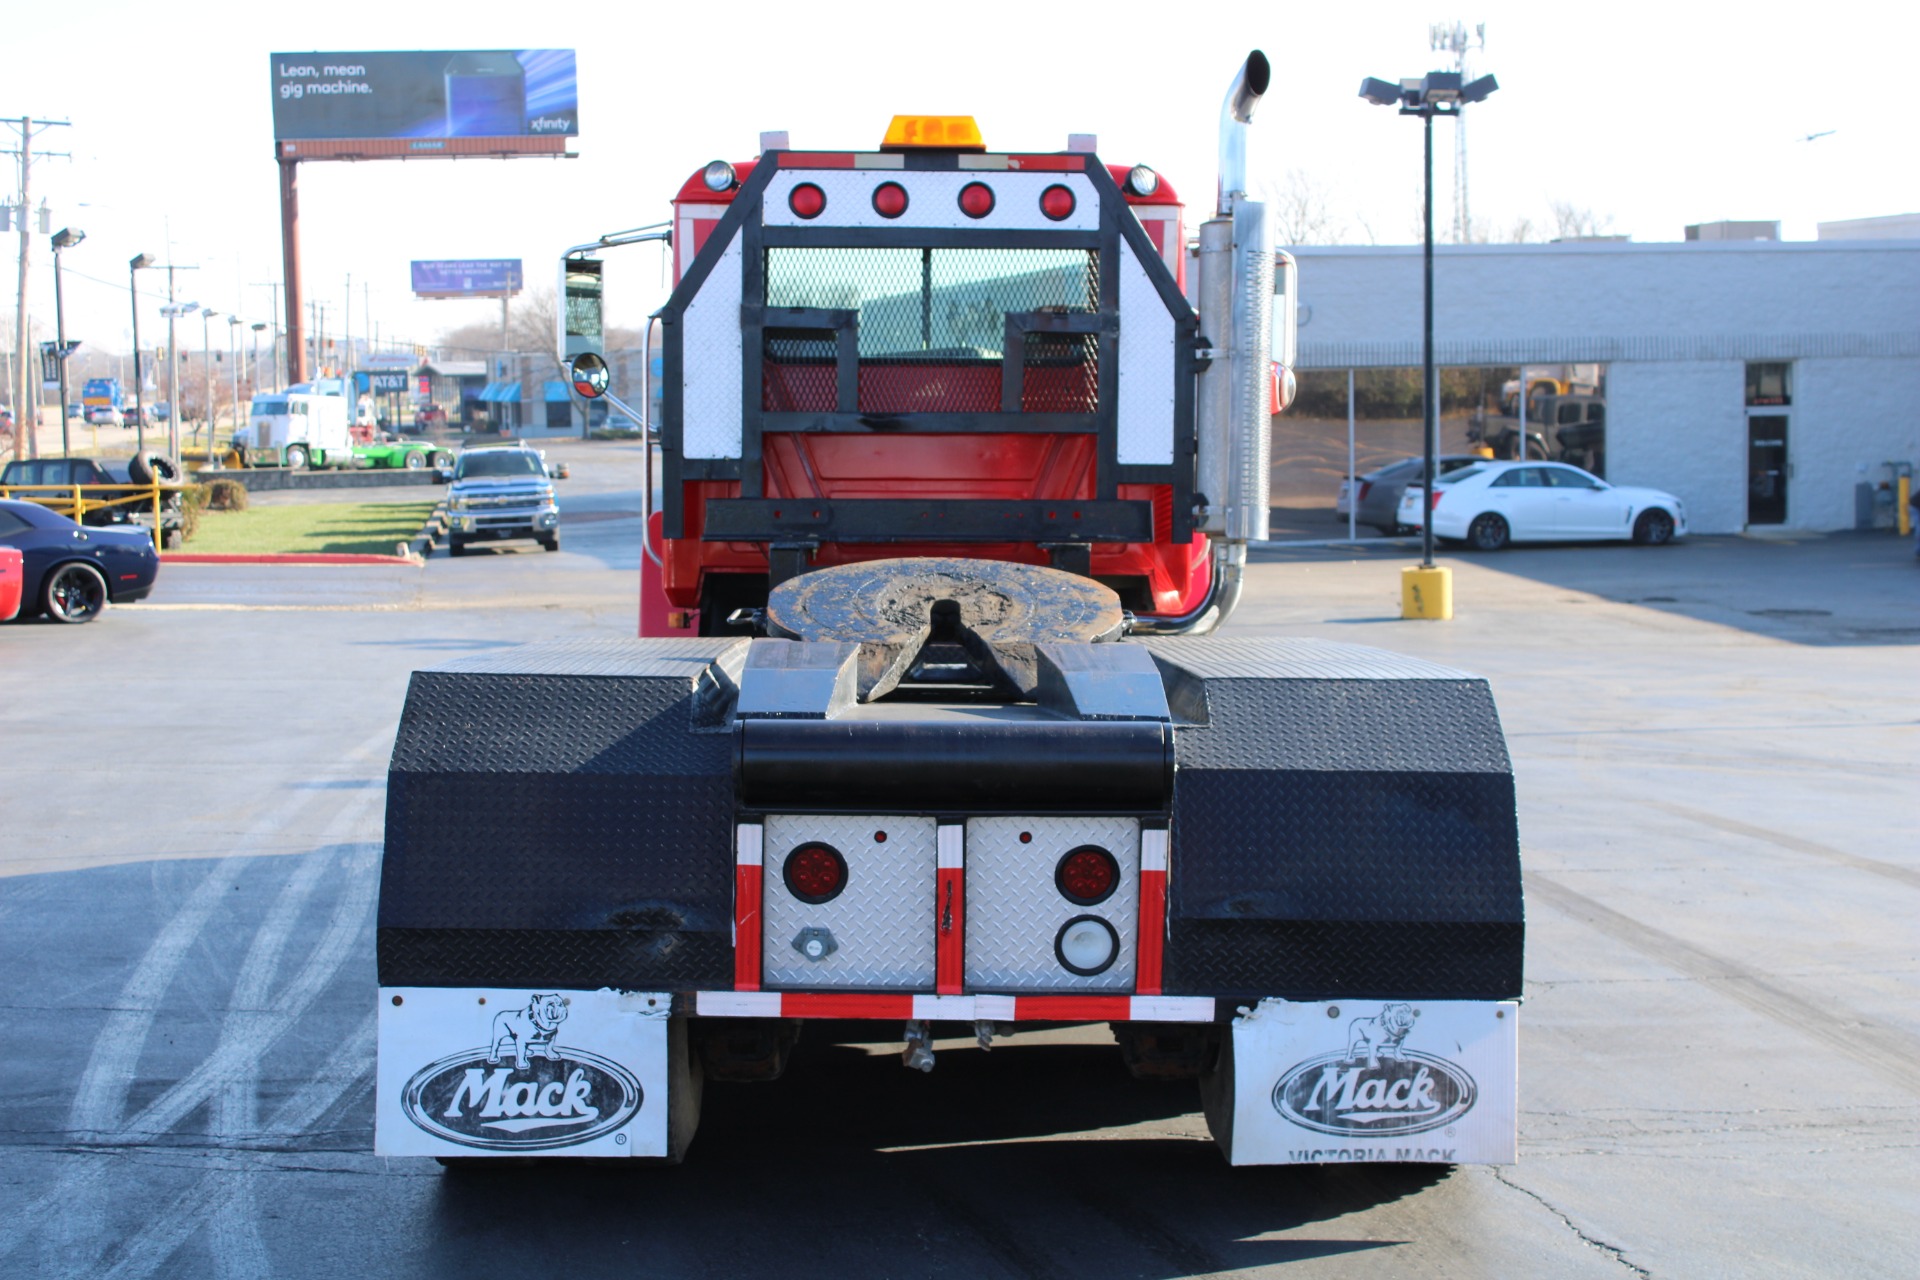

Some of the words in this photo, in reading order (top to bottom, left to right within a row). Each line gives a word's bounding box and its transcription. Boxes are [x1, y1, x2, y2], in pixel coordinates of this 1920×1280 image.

[280, 63, 320, 78] Lean,
[323, 65, 366, 76] mean
[280, 80, 304, 99] gig
[306, 80, 373, 95] machine.
[530, 116, 571, 132] xfinity
[373, 375, 406, 388] AT&T
[443, 1067, 599, 1133] Mack
[1303, 1067, 1441, 1124] Mack
[1288, 1149, 1387, 1163] VICTORIA
[1395, 1149, 1456, 1163] MACK
